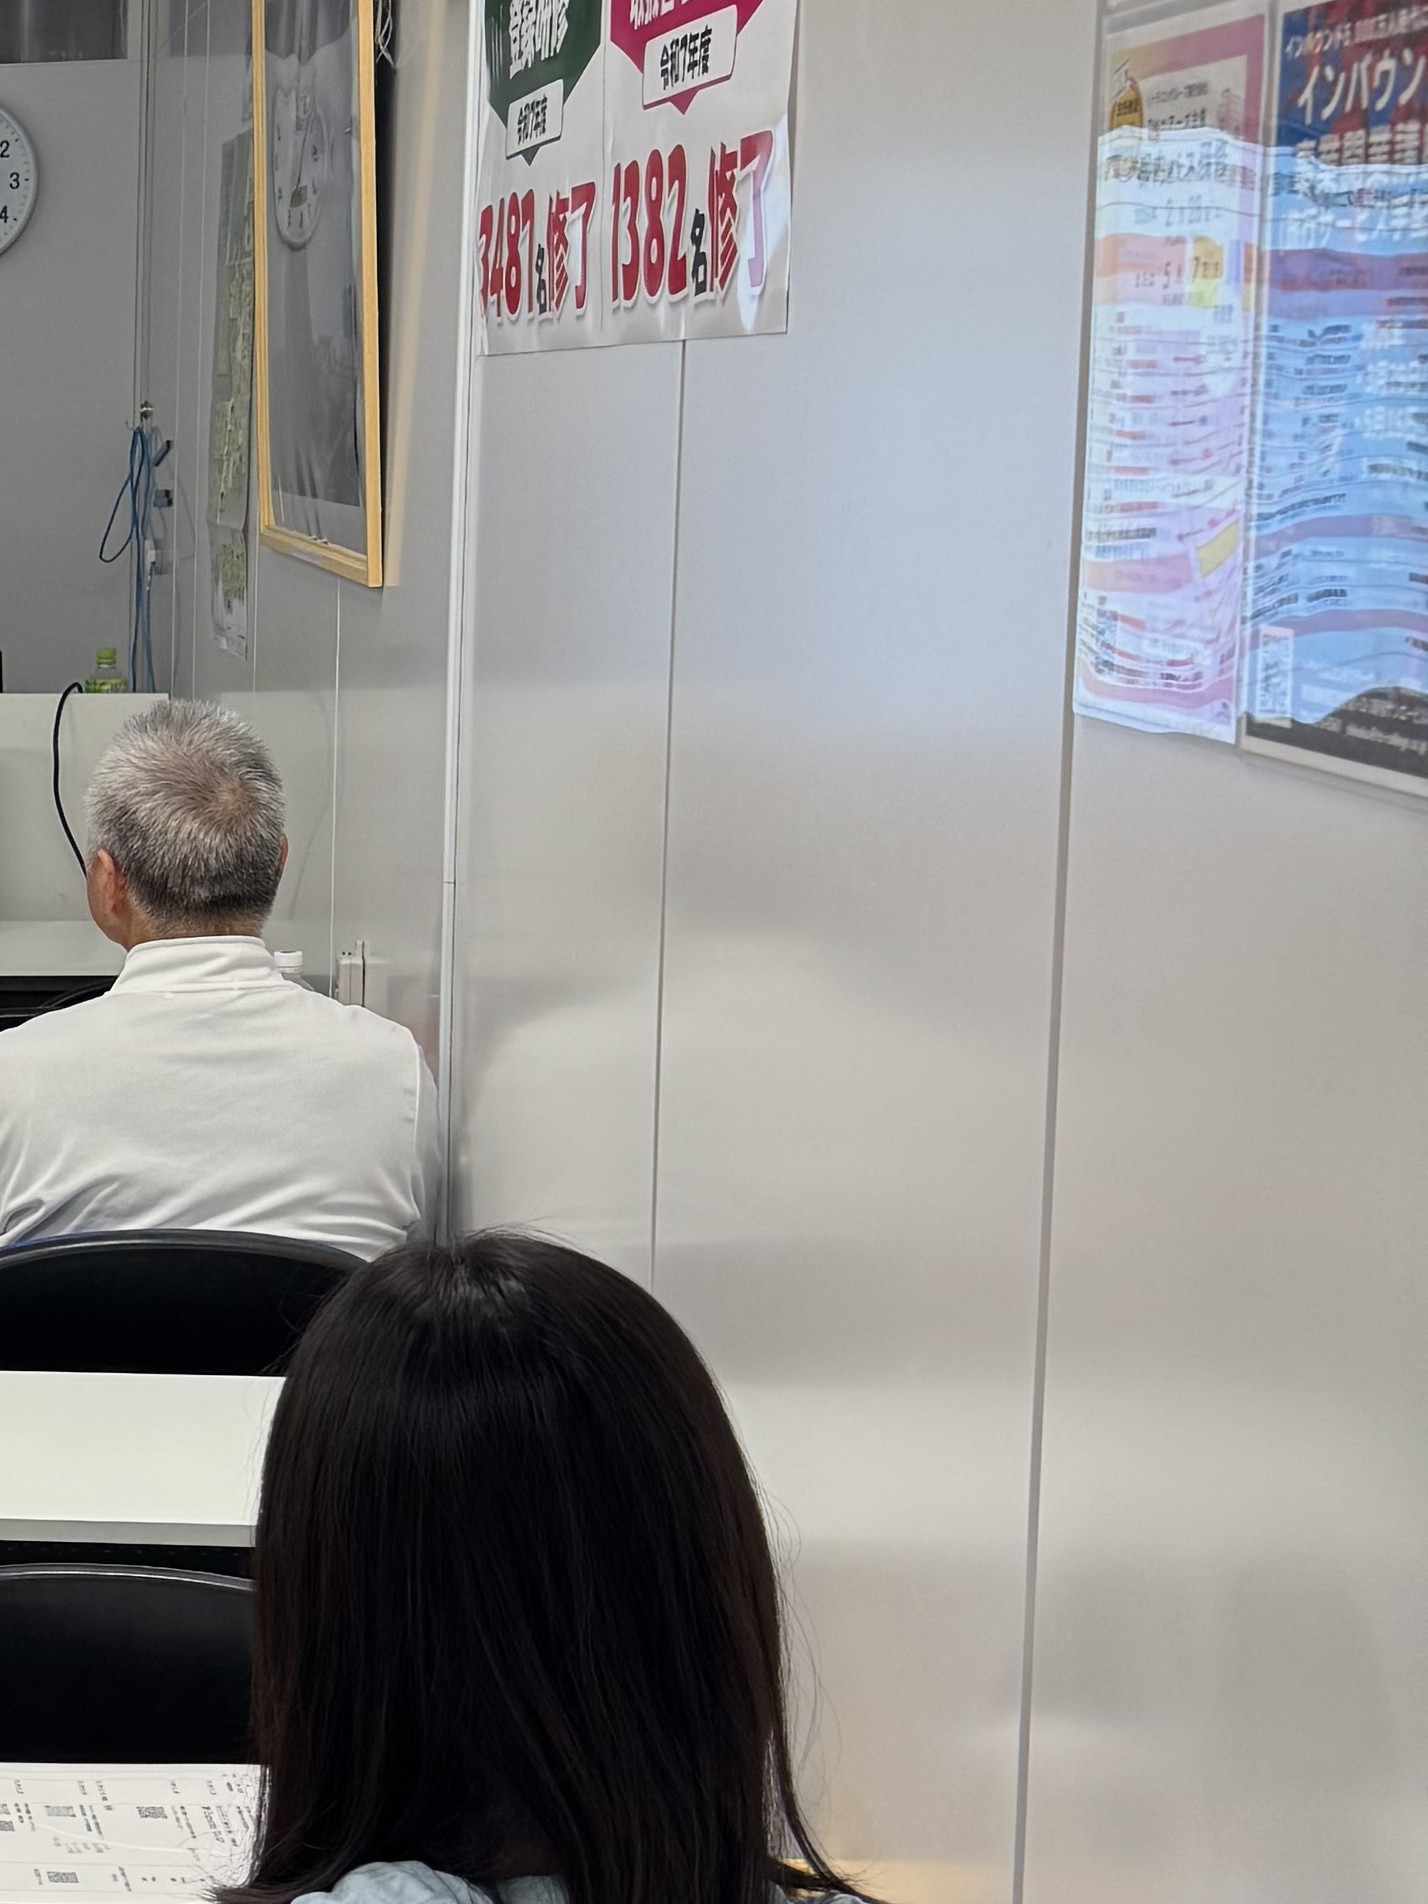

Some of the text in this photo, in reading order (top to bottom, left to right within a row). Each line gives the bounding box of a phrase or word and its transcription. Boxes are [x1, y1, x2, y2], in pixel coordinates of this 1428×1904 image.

[659, 24, 713, 91] 令和7年度
[0, 140, 11, 158] 2
[9, 172, 20, 190] 3
[0, 205, 9, 223] 4
[612, 130, 773, 303] 1382名修了
[479, 182, 596, 319] 3487名修了
